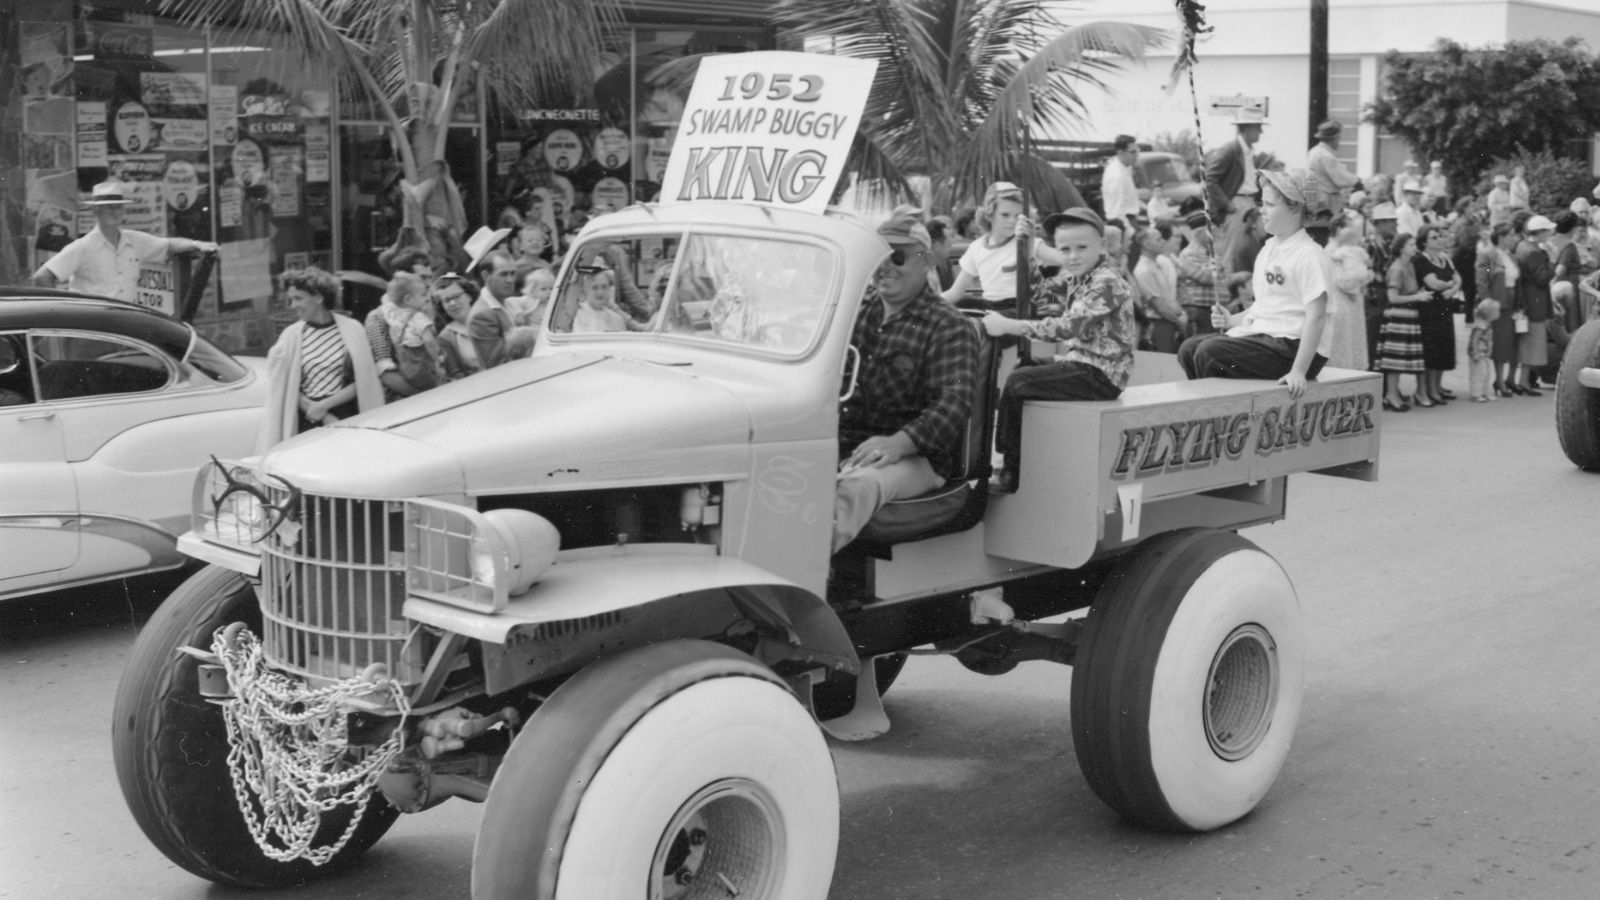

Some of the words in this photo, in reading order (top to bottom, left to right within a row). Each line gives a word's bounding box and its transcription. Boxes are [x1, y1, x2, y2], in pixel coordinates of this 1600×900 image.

[717, 71, 824, 103] 1952
[686, 107, 767, 136] SWAMP
[769, 110, 847, 140] BUGGY
[676, 145, 827, 204] KING
[1110, 412, 1251, 480] FLYING
[1255, 391, 1375, 455] SAUCER
